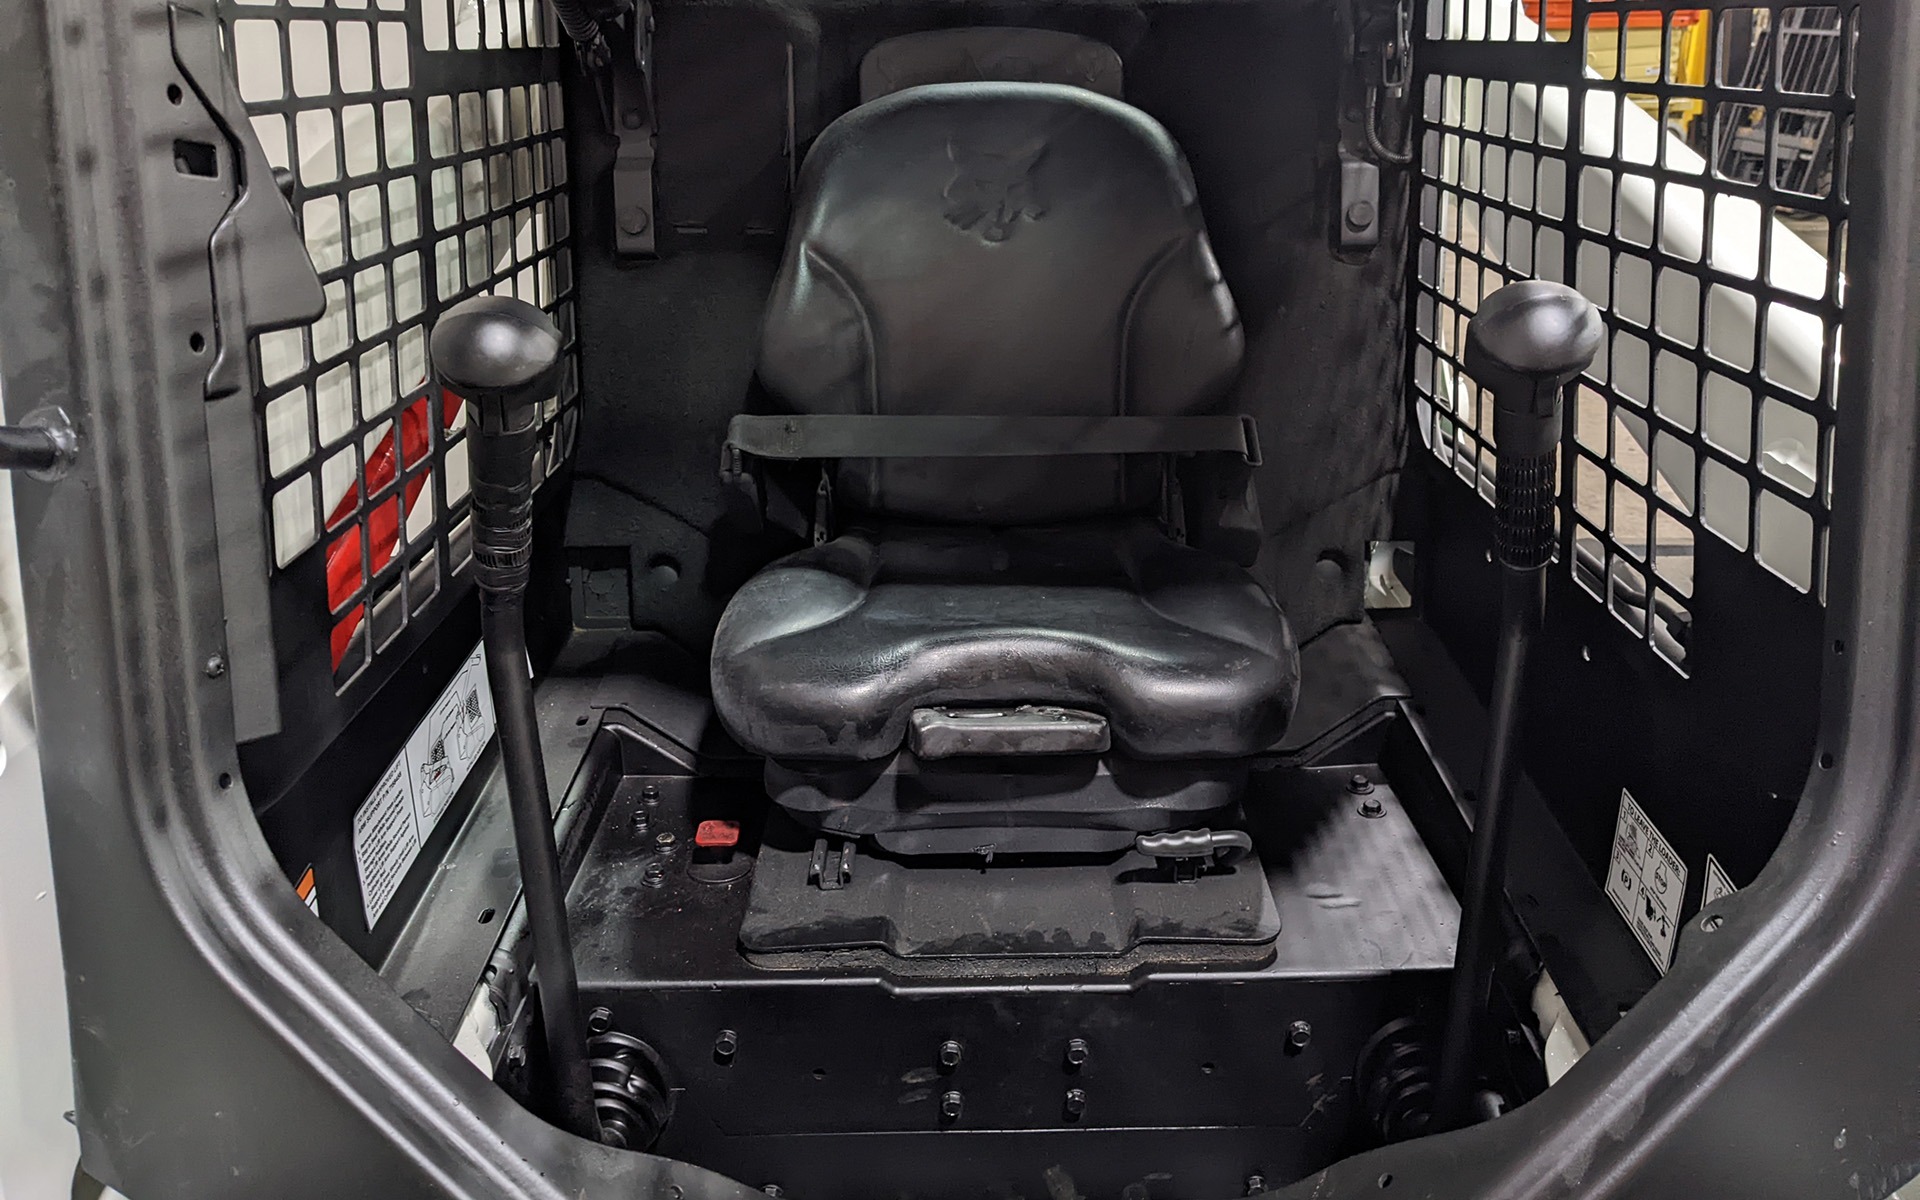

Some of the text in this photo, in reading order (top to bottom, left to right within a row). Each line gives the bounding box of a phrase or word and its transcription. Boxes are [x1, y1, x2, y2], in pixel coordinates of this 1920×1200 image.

[1627, 802, 1634, 815] TO
[1634, 811, 1649, 834] LEAVE
[1649, 830, 1659, 847] THE
[1655, 871, 1667, 889] STOP
